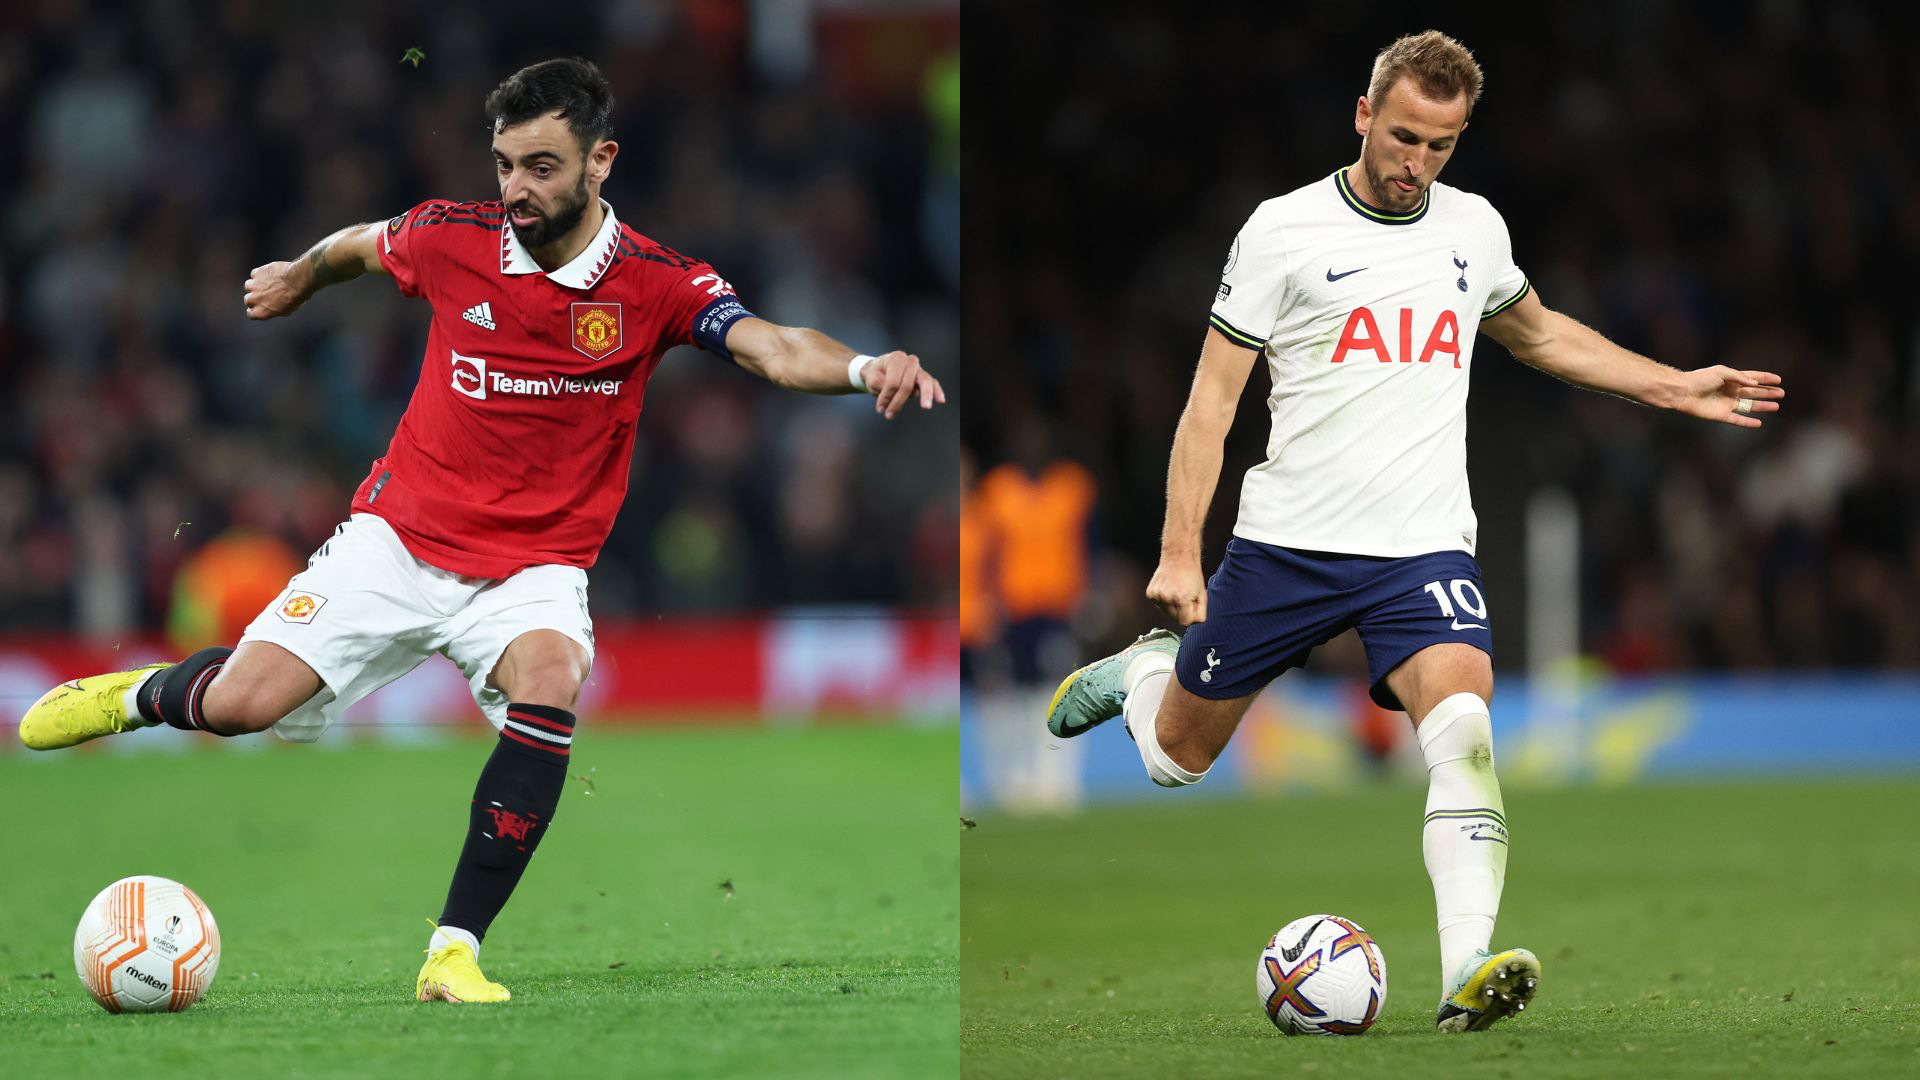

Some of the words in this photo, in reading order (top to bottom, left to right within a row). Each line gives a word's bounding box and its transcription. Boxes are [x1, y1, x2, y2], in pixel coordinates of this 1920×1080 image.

[462, 311, 497, 331] adidas
[580, 312, 613, 326] MANCHESTER
[700, 317, 709, 332] NO
[708, 308, 720, 317] TO
[586, 340, 609, 349] UNITED
[1331, 307, 1462, 369] AIA
[488, 371, 623, 396] TeamViewer
[1424, 579, 1487, 620] 10
[153, 936, 179, 953] EUROPA
[126, 966, 168, 991] molten
